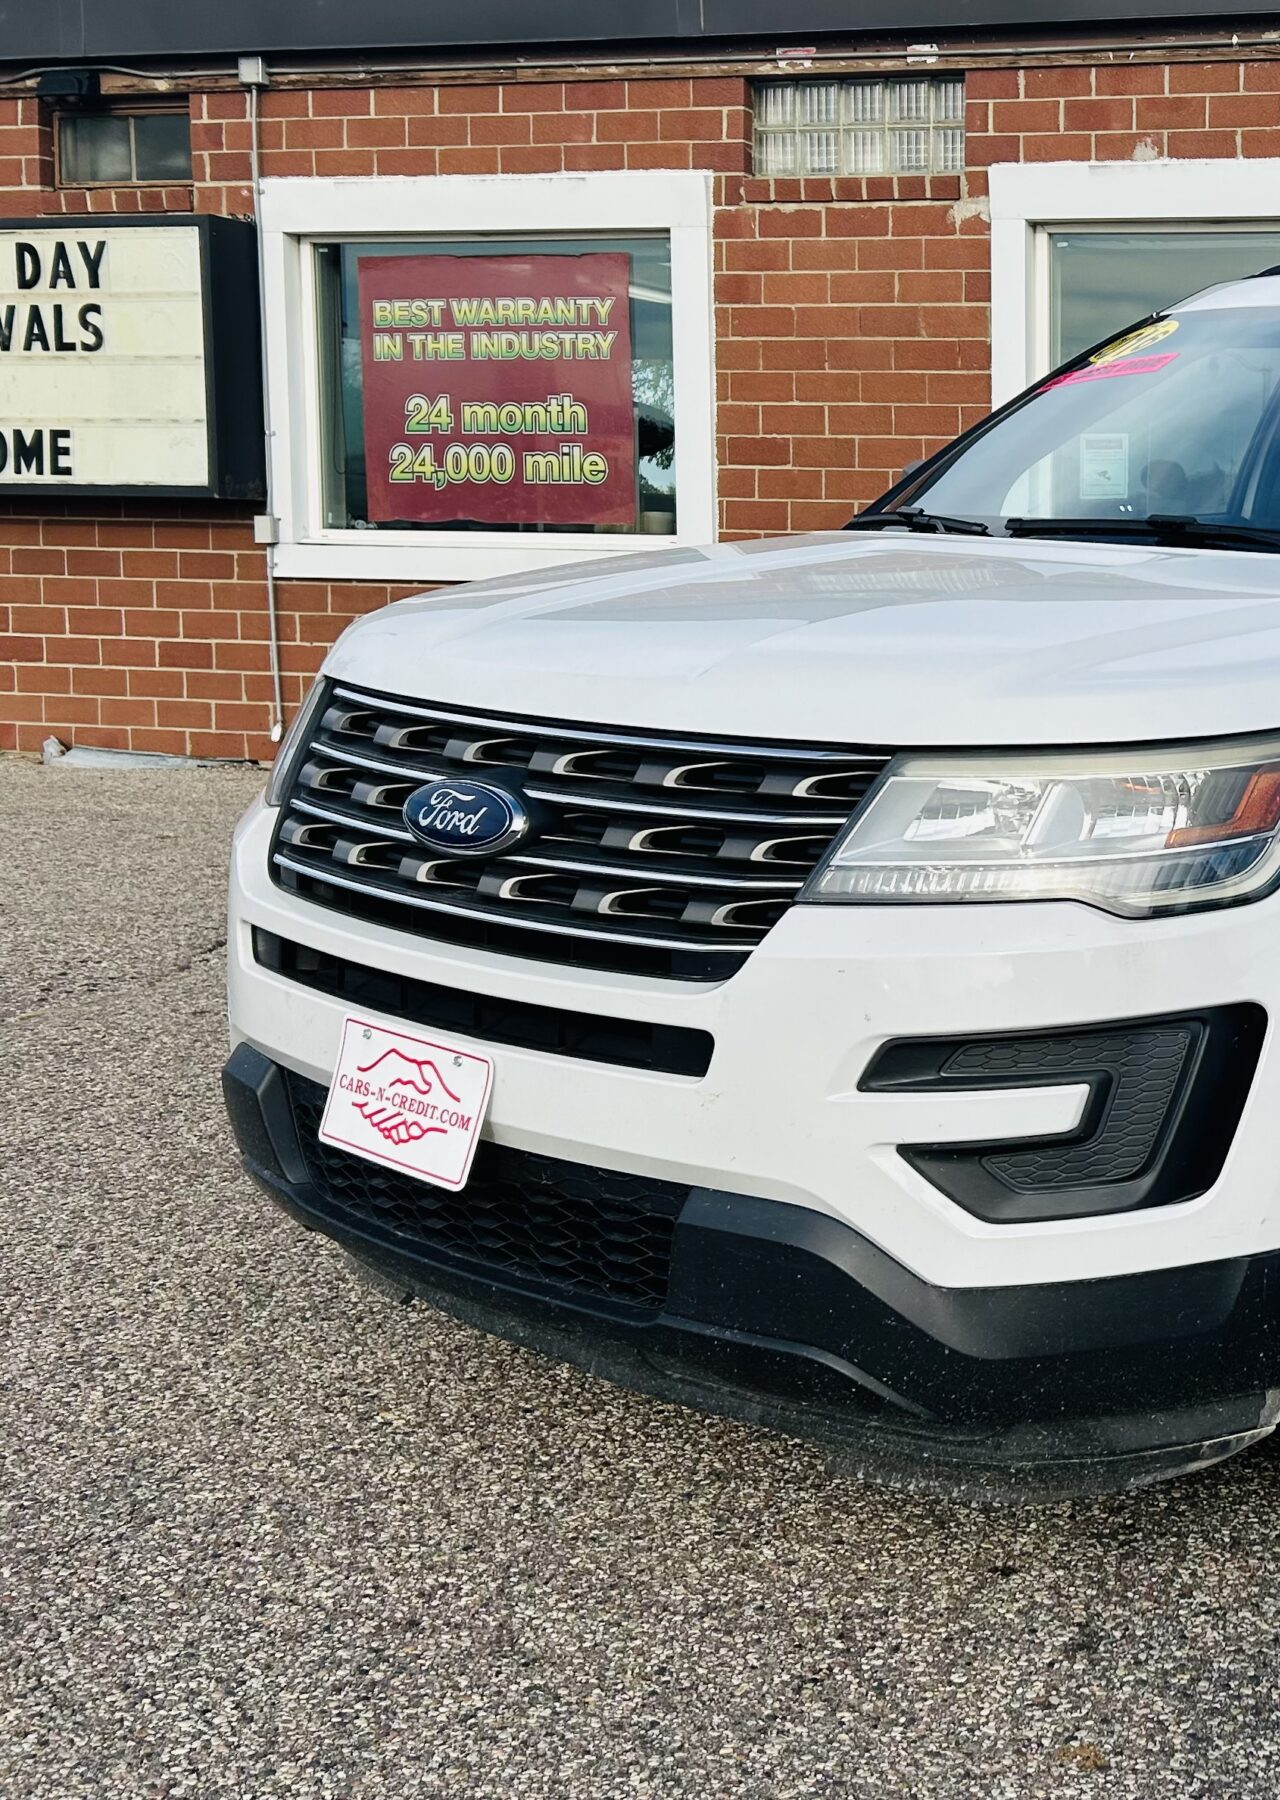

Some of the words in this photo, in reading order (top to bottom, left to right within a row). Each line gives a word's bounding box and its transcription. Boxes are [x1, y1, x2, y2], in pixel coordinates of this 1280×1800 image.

[15, 241, 106, 289] DAY
[373, 298, 445, 327] BEST
[449, 297, 616, 327] WARRANTY
[373, 333, 402, 361] IN
[408, 332, 465, 361] THE
[470, 331, 618, 360] INDUSTRY
[405, 394, 454, 434] 24
[461, 393, 588, 435] month
[389, 443, 515, 491] 24,000
[523, 443, 608, 485] mile
[418, 788, 488, 835] Ford
[339, 1074, 472, 1132] CARS-N-CREDIT.COM
